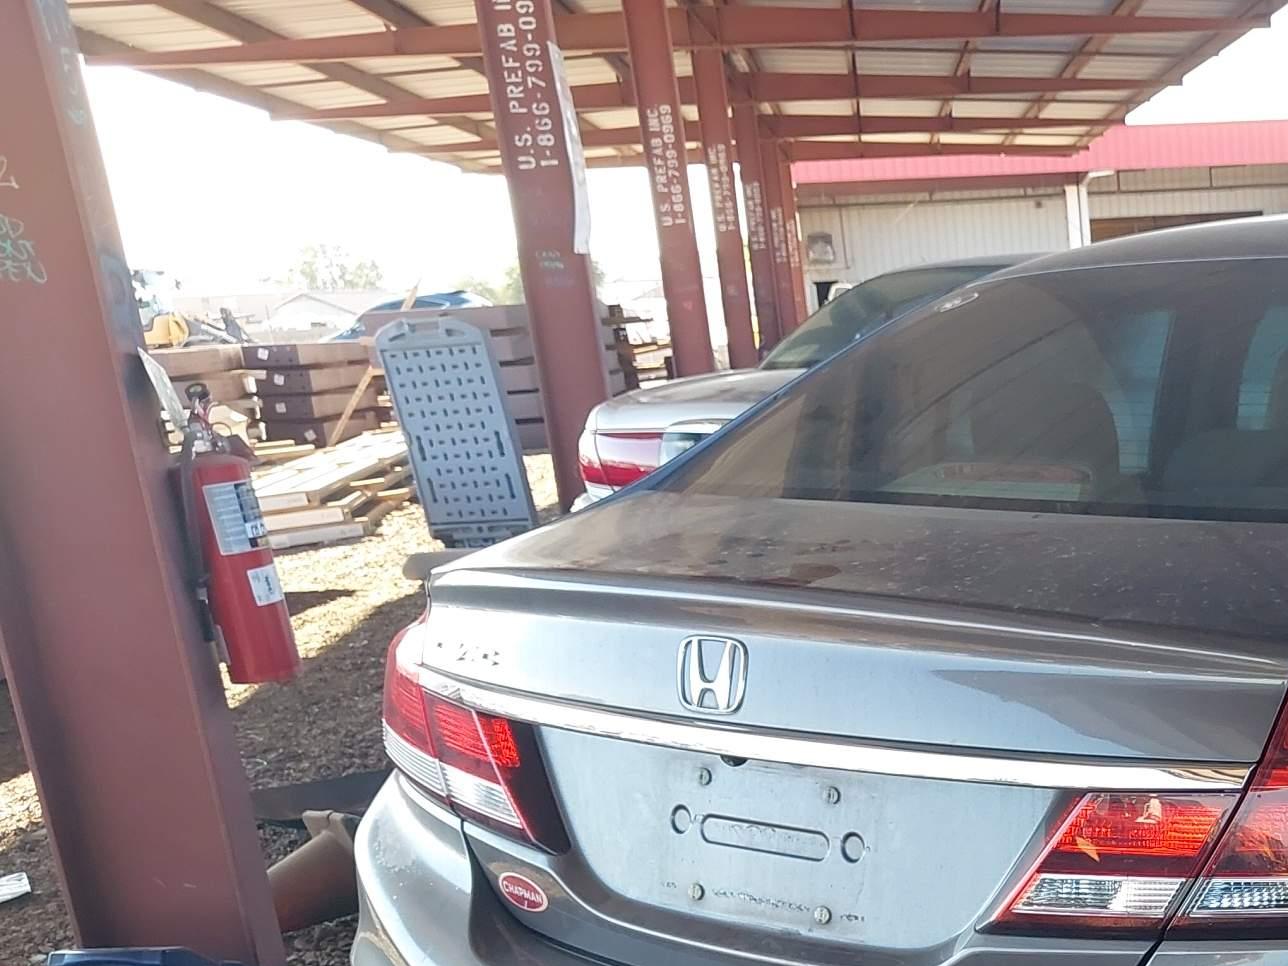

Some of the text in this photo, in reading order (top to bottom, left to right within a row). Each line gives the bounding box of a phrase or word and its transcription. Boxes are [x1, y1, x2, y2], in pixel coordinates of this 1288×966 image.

[497, 23, 528, 113] PREFAB
[515, 126, 537, 170] U.S.
[650, 138, 668, 192] PREFAB
[503, 881, 543, 904] CHAPMAN
